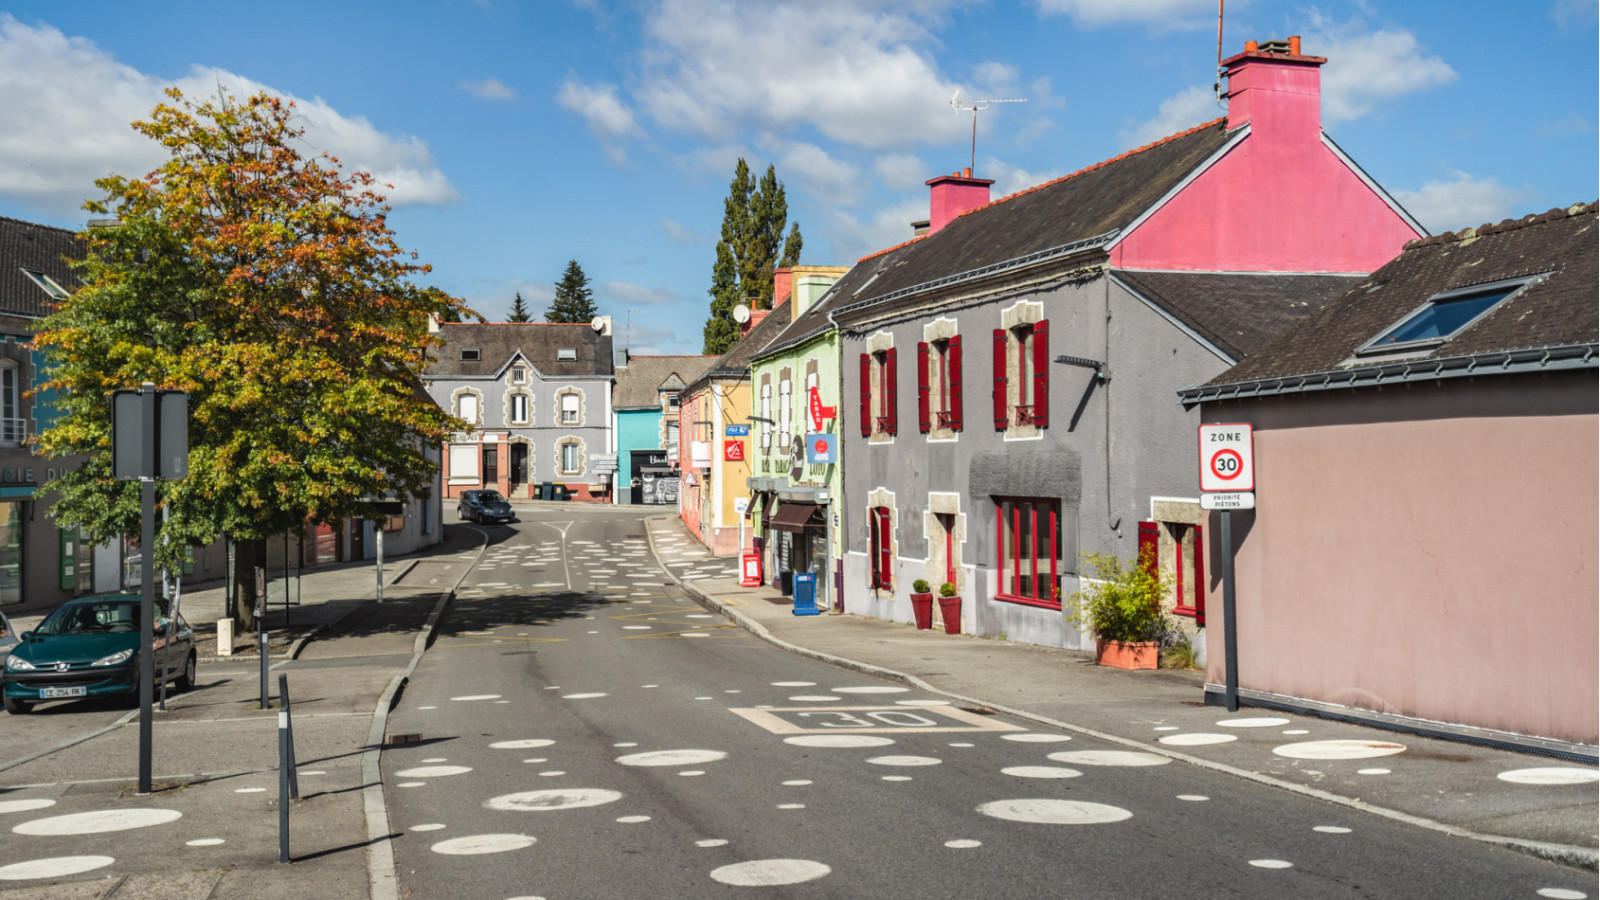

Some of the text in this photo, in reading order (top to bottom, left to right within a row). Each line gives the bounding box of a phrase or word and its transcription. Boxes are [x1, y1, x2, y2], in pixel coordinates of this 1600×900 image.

[812, 395, 821, 422] TABAC
[1210, 432, 1242, 442] ZONE
[1217, 458, 1237, 471] 30
[3, 467, 34, 483] CIE
[798, 711, 938, 728] 30
